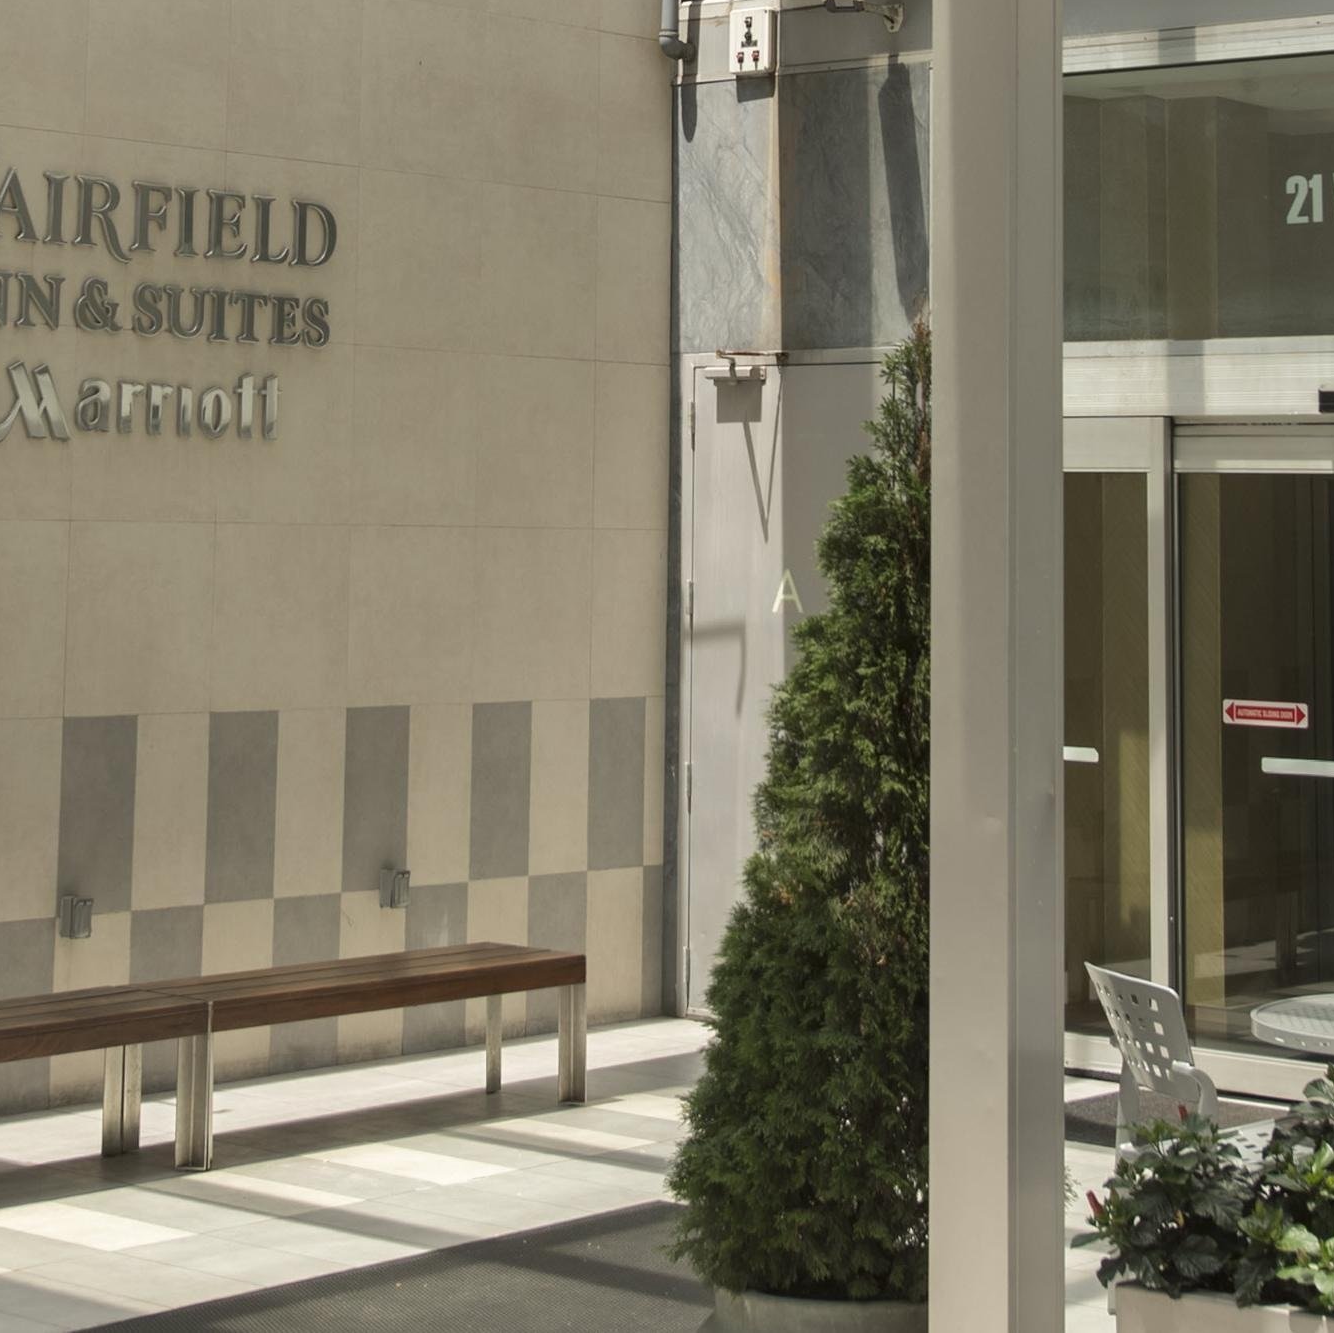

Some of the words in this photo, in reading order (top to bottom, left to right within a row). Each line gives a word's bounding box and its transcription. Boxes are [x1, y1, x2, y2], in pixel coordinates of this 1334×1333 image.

[1285, 174, 1323, 224] 21
[74, 277, 122, 332] &
[131, 282, 332, 349] SUITES
[772, 568, 804, 614] A
